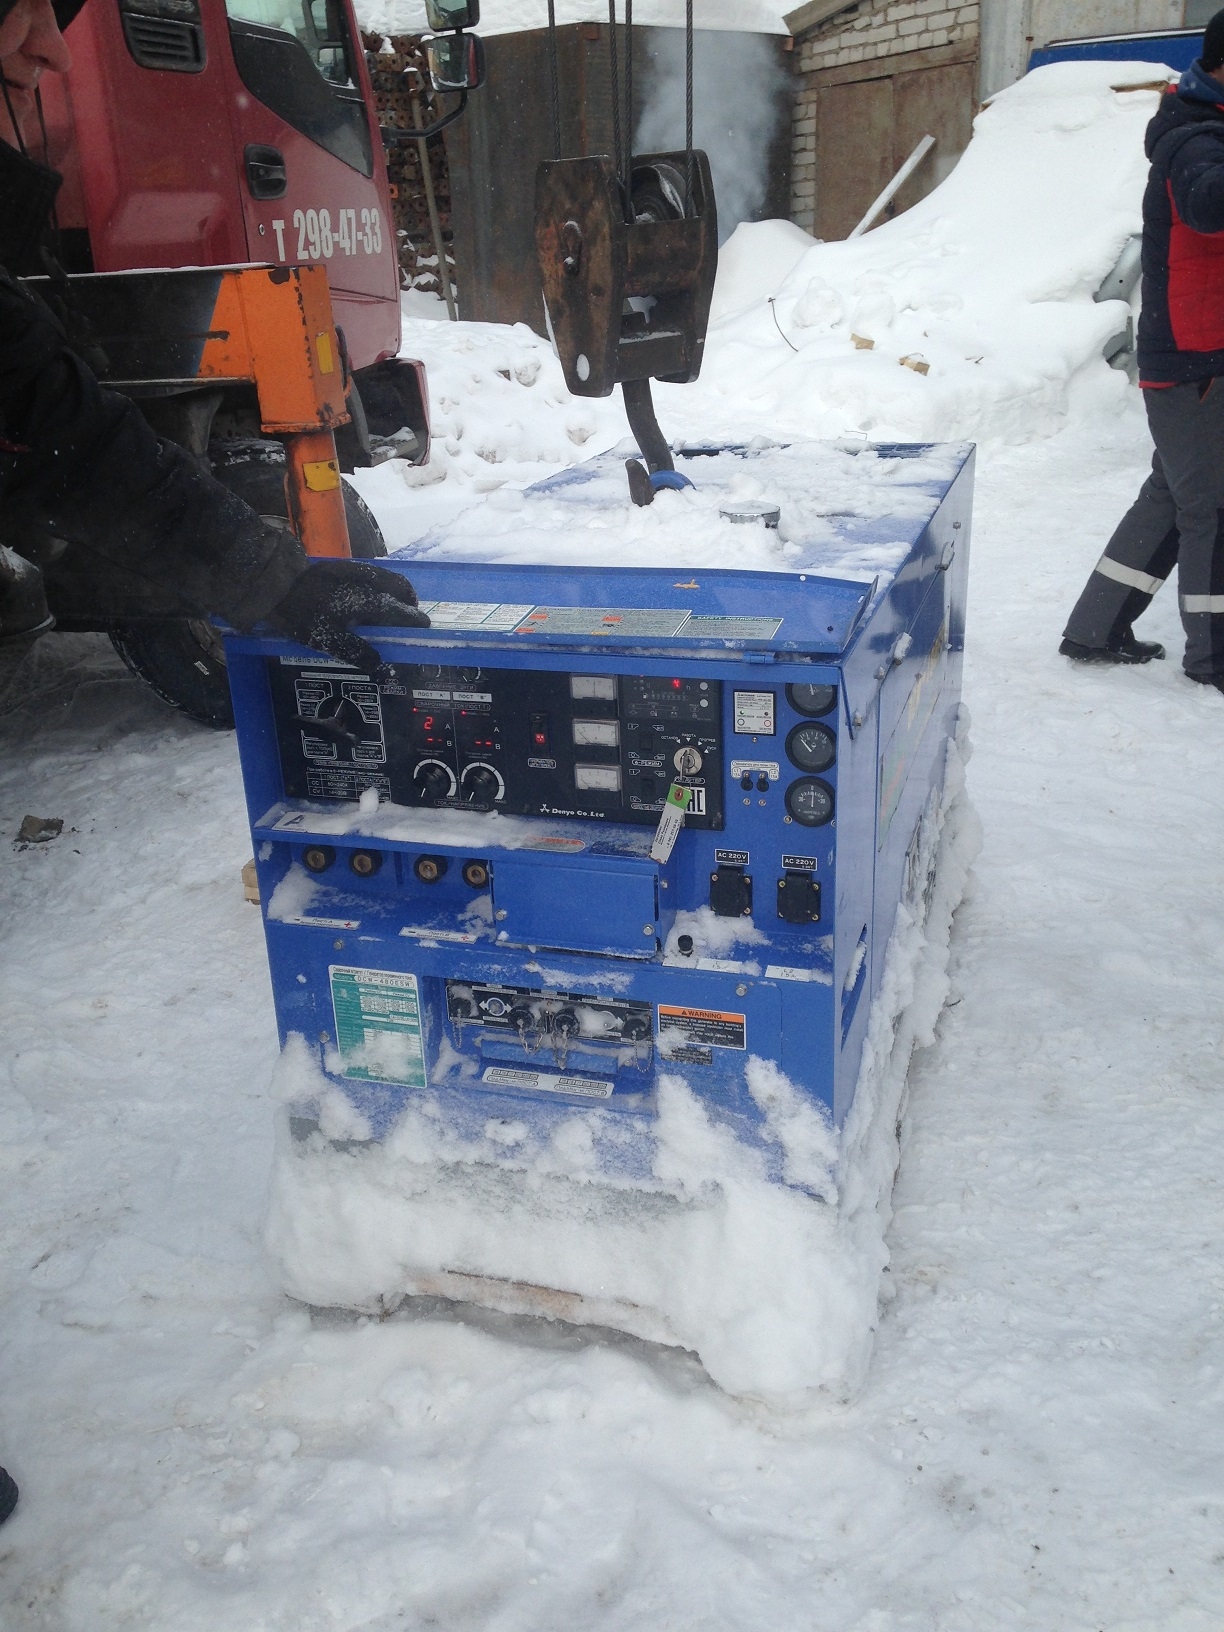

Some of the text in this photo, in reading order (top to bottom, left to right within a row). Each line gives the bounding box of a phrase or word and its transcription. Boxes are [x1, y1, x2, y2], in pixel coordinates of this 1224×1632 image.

[272, 208, 382, 262] Т 298-47-33
[551, 808, 575, 816] Denyo
[688, 1010, 722, 1020] WARNING
